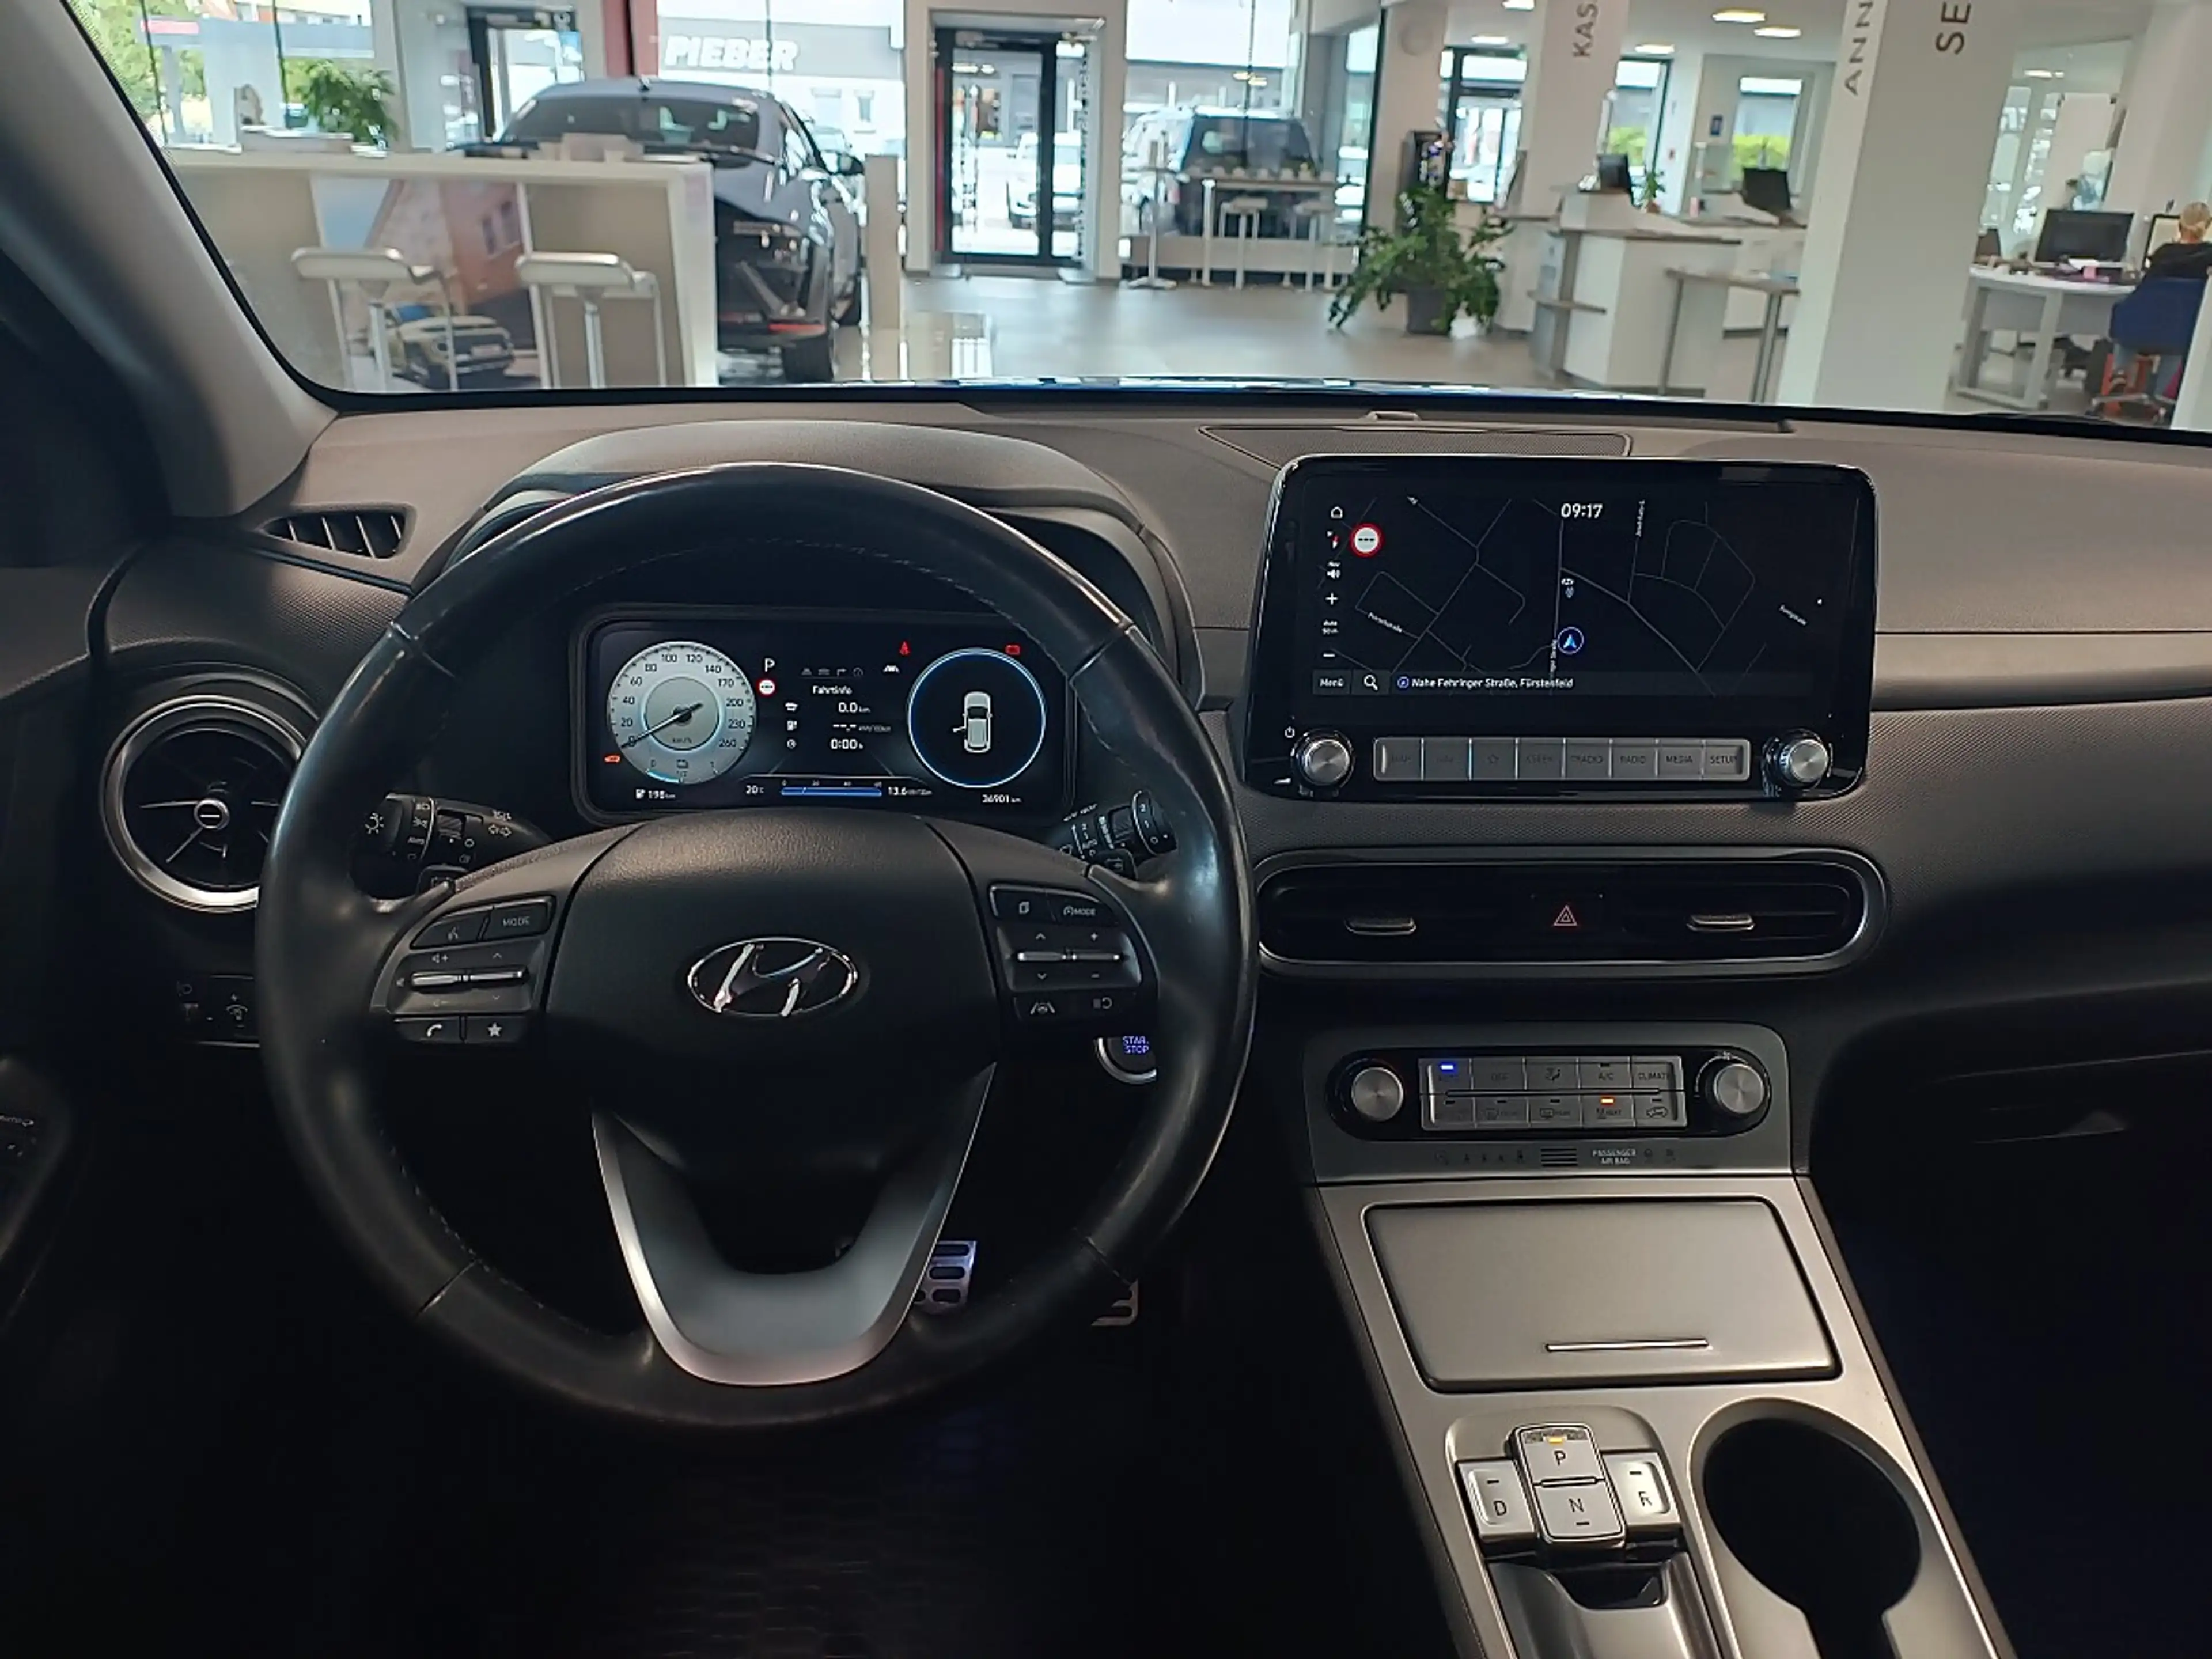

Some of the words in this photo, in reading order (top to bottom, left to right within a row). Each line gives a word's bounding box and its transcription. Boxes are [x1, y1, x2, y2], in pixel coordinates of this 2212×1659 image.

[1572, 0, 1599, 58] KAS
[1935, 2, 1971, 55] SE
[664, 35, 799, 71] PIEBER
[1561, 503, 1603, 518] 09:17
[661, 654, 677, 662] 100
[686, 654, 703, 662] 120
[645, 664, 657, 672] 80
[706, 665, 721, 673] 140
[765, 658, 775, 672] P
[630, 677, 642, 686] 60
[718, 679, 734, 688] 170
[623, 697, 635, 705] 40
[726, 698, 744, 707] 200
[838, 702, 858, 713] 0.0
[621, 718, 633, 727] 20
[728, 719, 745, 729] 230
[831, 739, 858, 749] 0:00
[1666, 756, 1693, 764] MEDIA
[1710, 756, 1738, 764] SETUP
[503, 916, 530, 927] MODE
[1122, 1036, 1150, 1044] STAR
[1124, 1045, 1149, 1054] STOP
[1555, 1450, 1566, 1466] P
[1494, 1500, 1507, 1516] D
[1569, 1498, 1584, 1513] N
